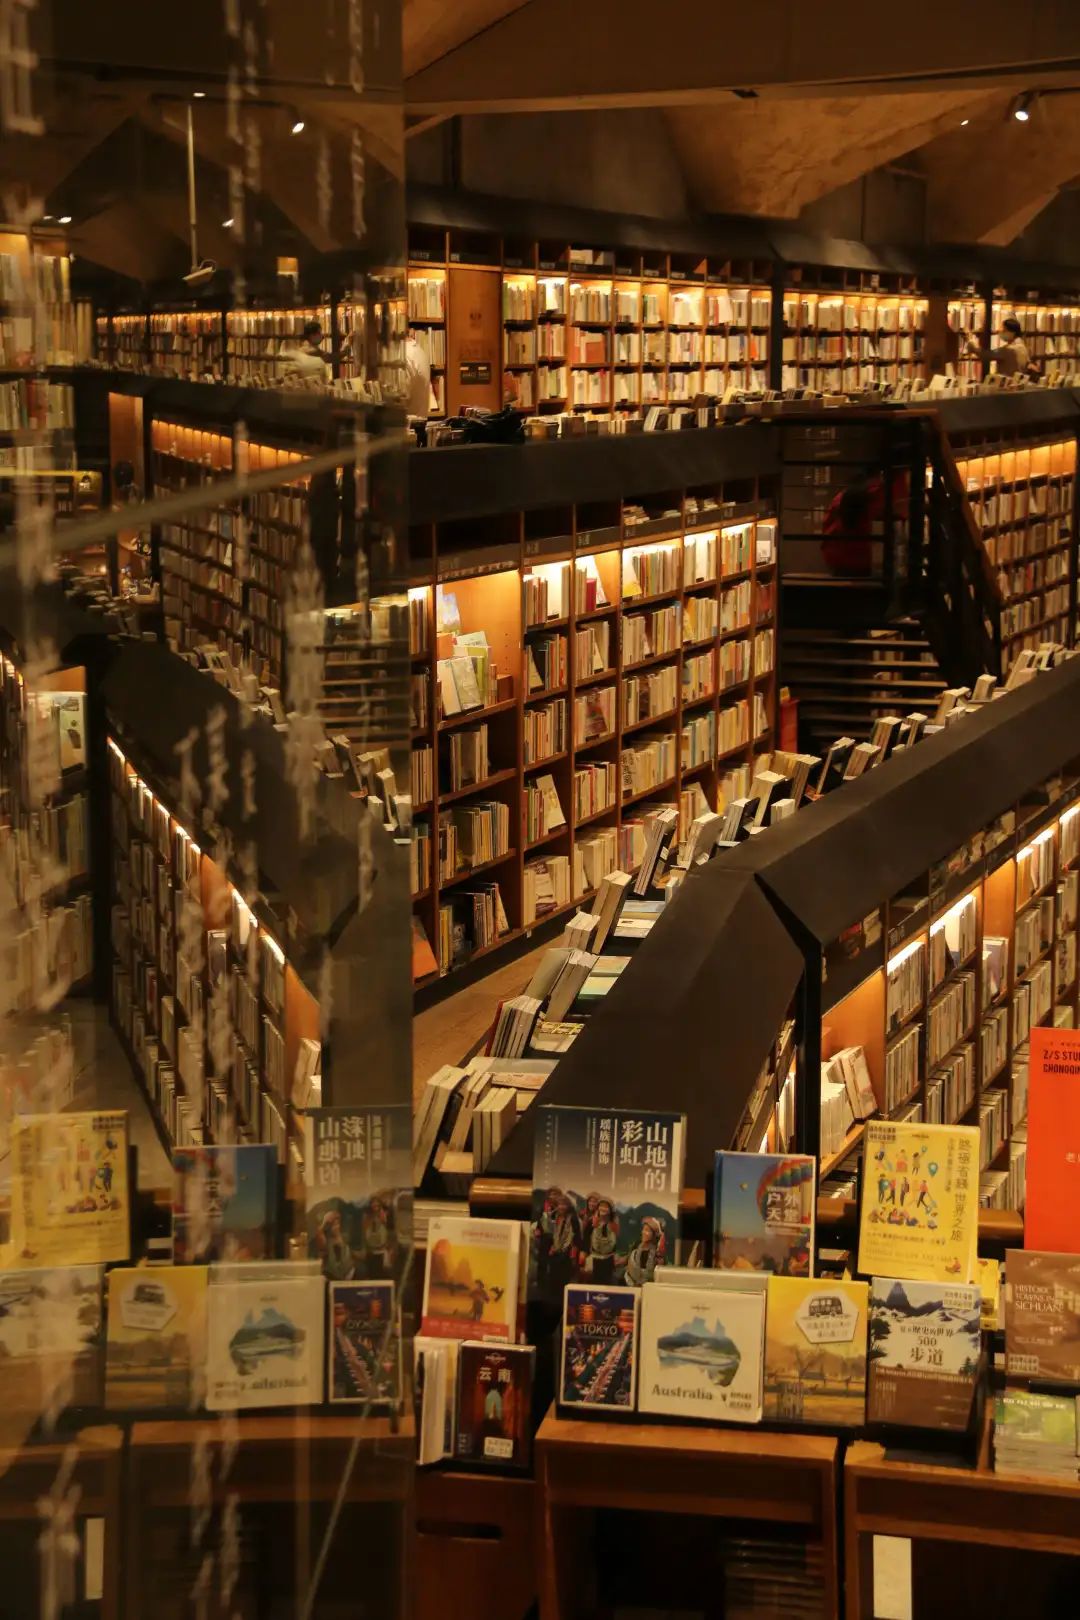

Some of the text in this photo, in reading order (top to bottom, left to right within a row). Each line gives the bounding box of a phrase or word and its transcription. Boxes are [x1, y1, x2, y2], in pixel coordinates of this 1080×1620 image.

[1062, 1050, 1080, 1062] STU
[620, 1120, 644, 1168] 彩虹
[644, 1121, 668, 1192] 山地的
[582, 1323, 618, 1337] TOKYO
[918, 1336, 937, 1348] 500
[479, 1367, 513, 1383] 云南
[651, 1383, 714, 1401] Australia
